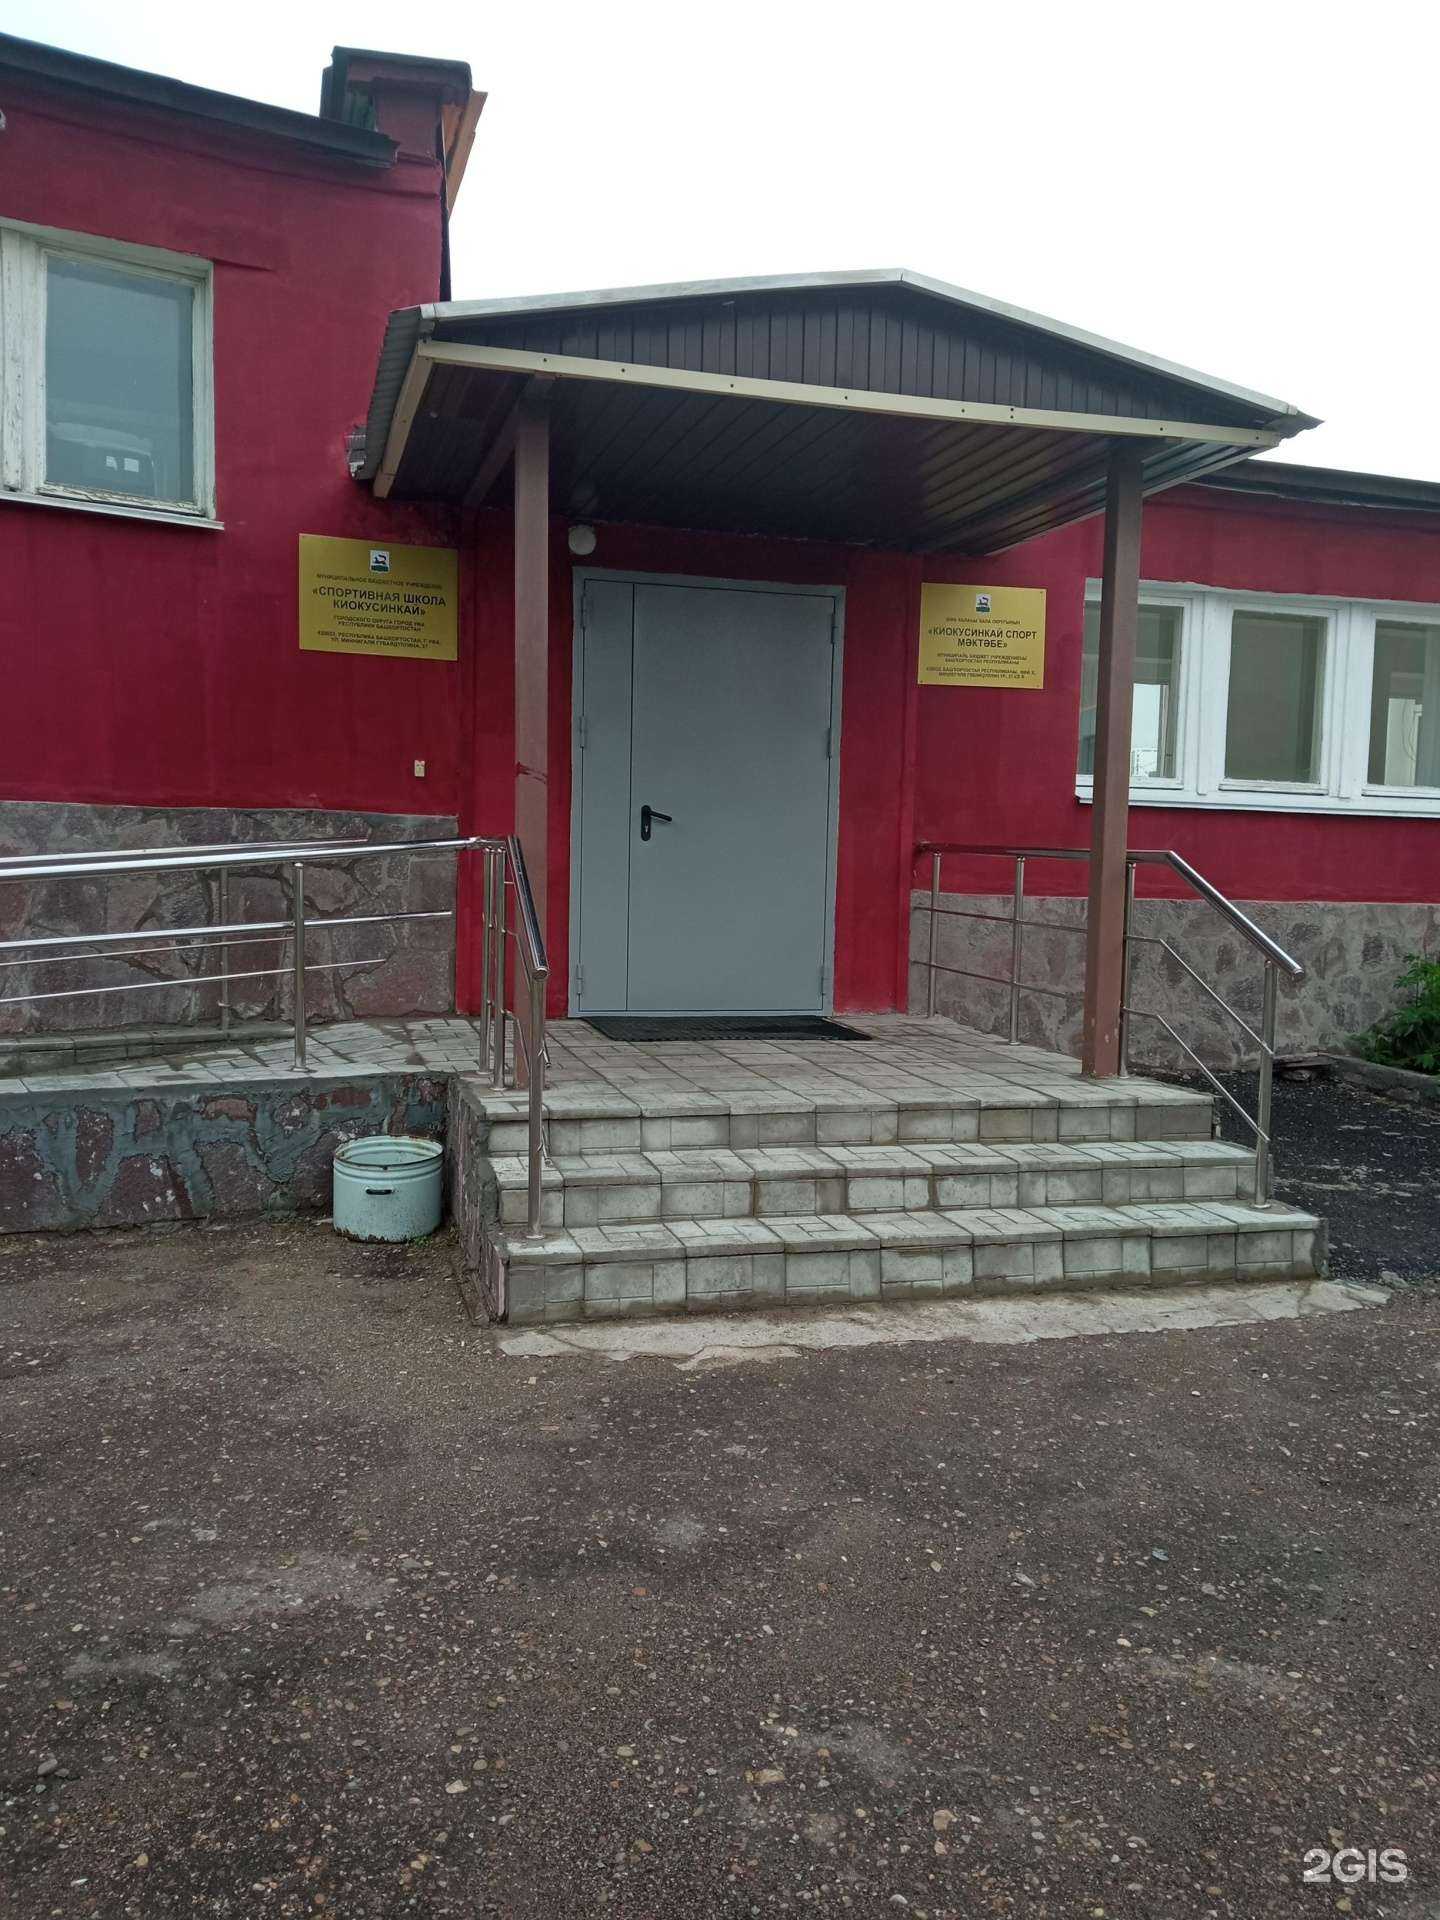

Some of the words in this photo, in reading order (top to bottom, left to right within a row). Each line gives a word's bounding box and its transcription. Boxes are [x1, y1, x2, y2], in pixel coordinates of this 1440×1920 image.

[312, 586, 400, 602] «СПОРТИВНАЯ
[404, 593, 446, 606] ШКОЛА
[333, 601, 426, 616] КИОКУСИНКАЙ»
[928, 627, 1003, 638] «КИОКУСИНКАЙ
[1006, 630, 1037, 639] СПОРТ
[957, 640, 1007, 648] МӘКТӘБЕ»
